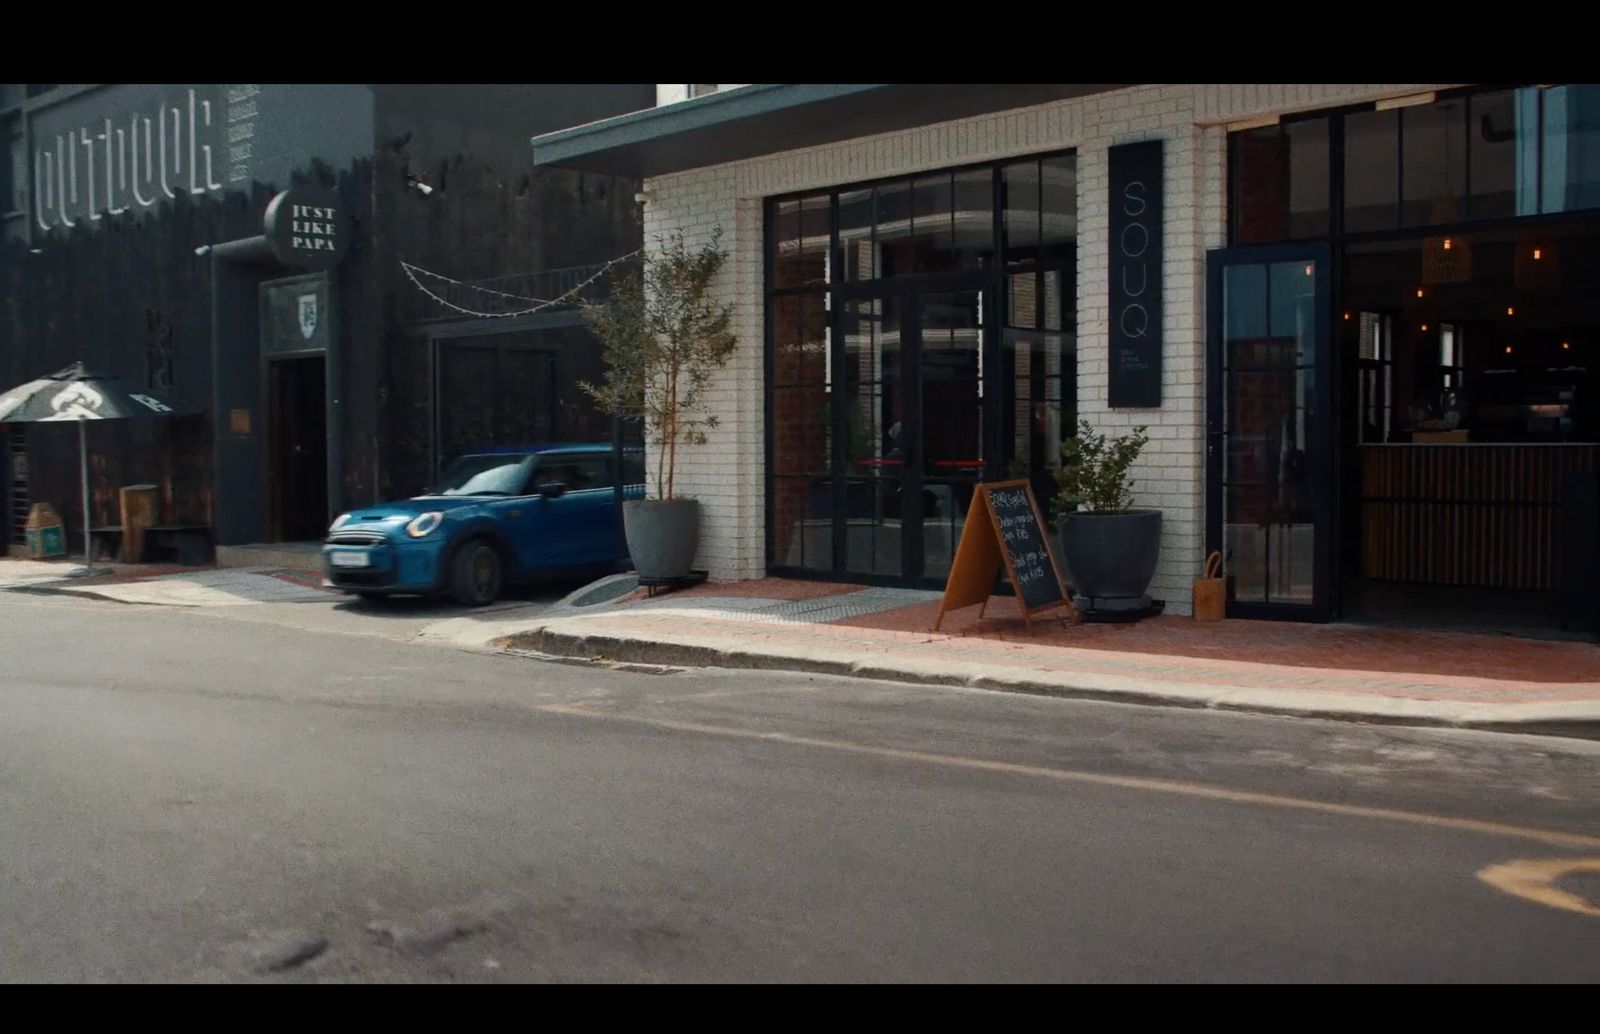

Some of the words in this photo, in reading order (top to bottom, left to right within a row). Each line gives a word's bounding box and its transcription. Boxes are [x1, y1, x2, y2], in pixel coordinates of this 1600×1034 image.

[293, 204, 336, 219] JUST
[293, 220, 336, 236] LIKE
[293, 237, 336, 251] PAPA
[1121, 181, 1149, 338] SOUQ
